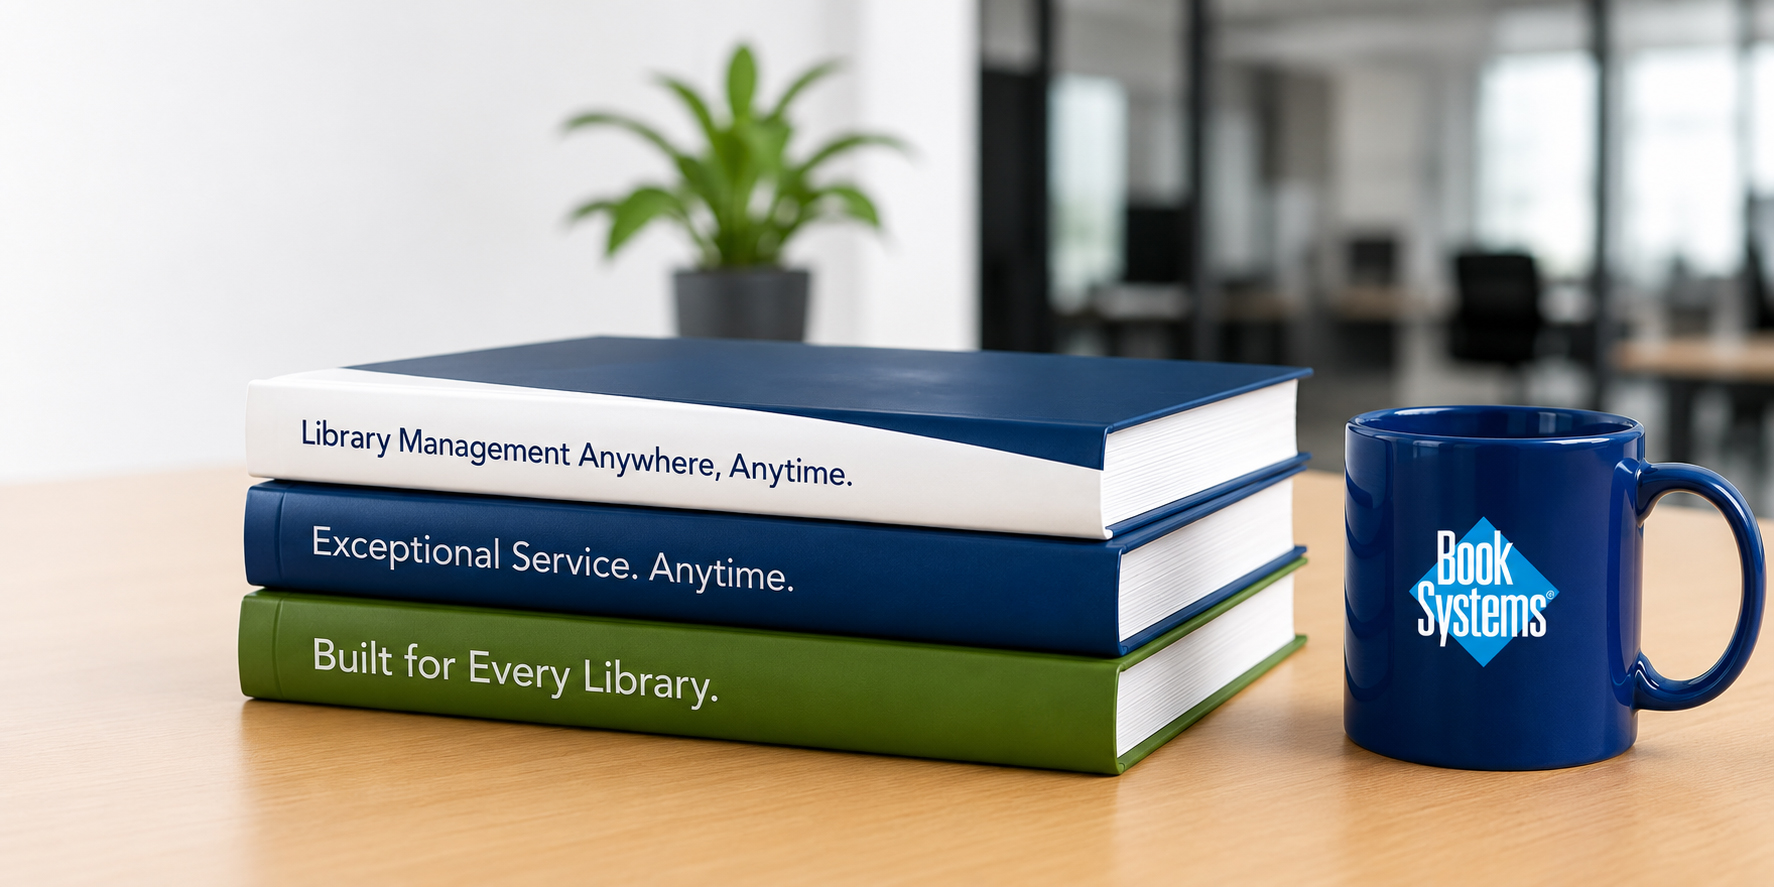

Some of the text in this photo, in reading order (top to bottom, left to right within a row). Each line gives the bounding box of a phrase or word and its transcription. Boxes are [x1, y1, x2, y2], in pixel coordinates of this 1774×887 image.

[302, 419, 853, 489] Library Management Anywhere, Anytime.
[313, 525, 794, 594] Exceptional Service. Anytime.
[1437, 530, 1513, 585] Book
[314, 637, 718, 711] Built for Every Library.
